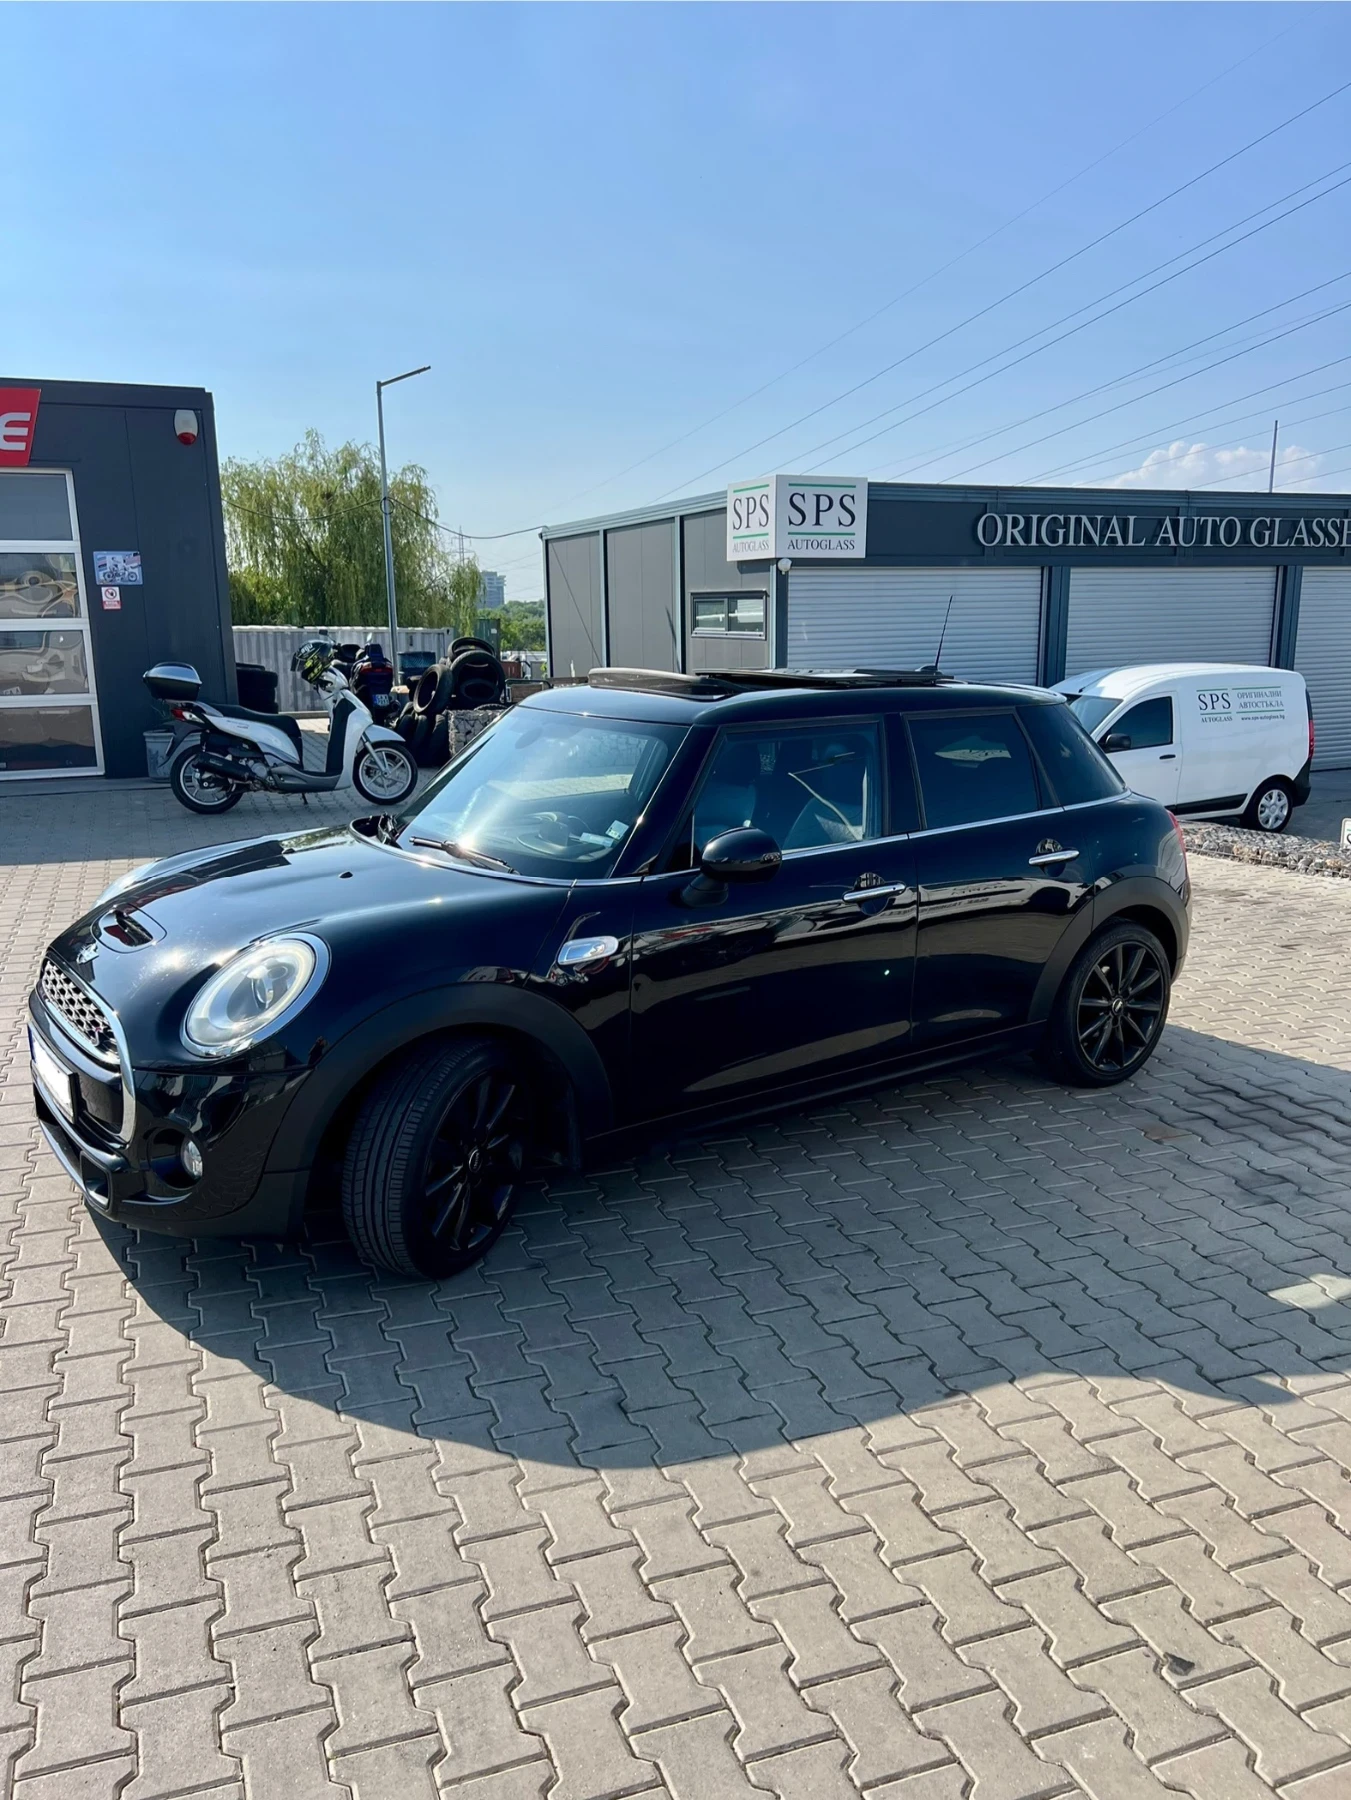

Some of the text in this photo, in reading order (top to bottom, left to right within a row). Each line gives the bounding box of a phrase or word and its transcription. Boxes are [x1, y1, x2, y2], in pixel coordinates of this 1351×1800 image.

[733, 494, 769, 530] SPS
[788, 492, 856, 527] SPS
[977, 513, 1351, 548] ORIGINAL AUTO GLASSE
[733, 540, 769, 552] AUTOGLASS
[788, 539, 855, 550] AUTOGLASS
[1198, 692, 1231, 711] SPS
[1237, 691, 1282, 699] ОРИГИНАЛНИ
[1239, 701, 1284, 709] АВТОСТЪКЛА
